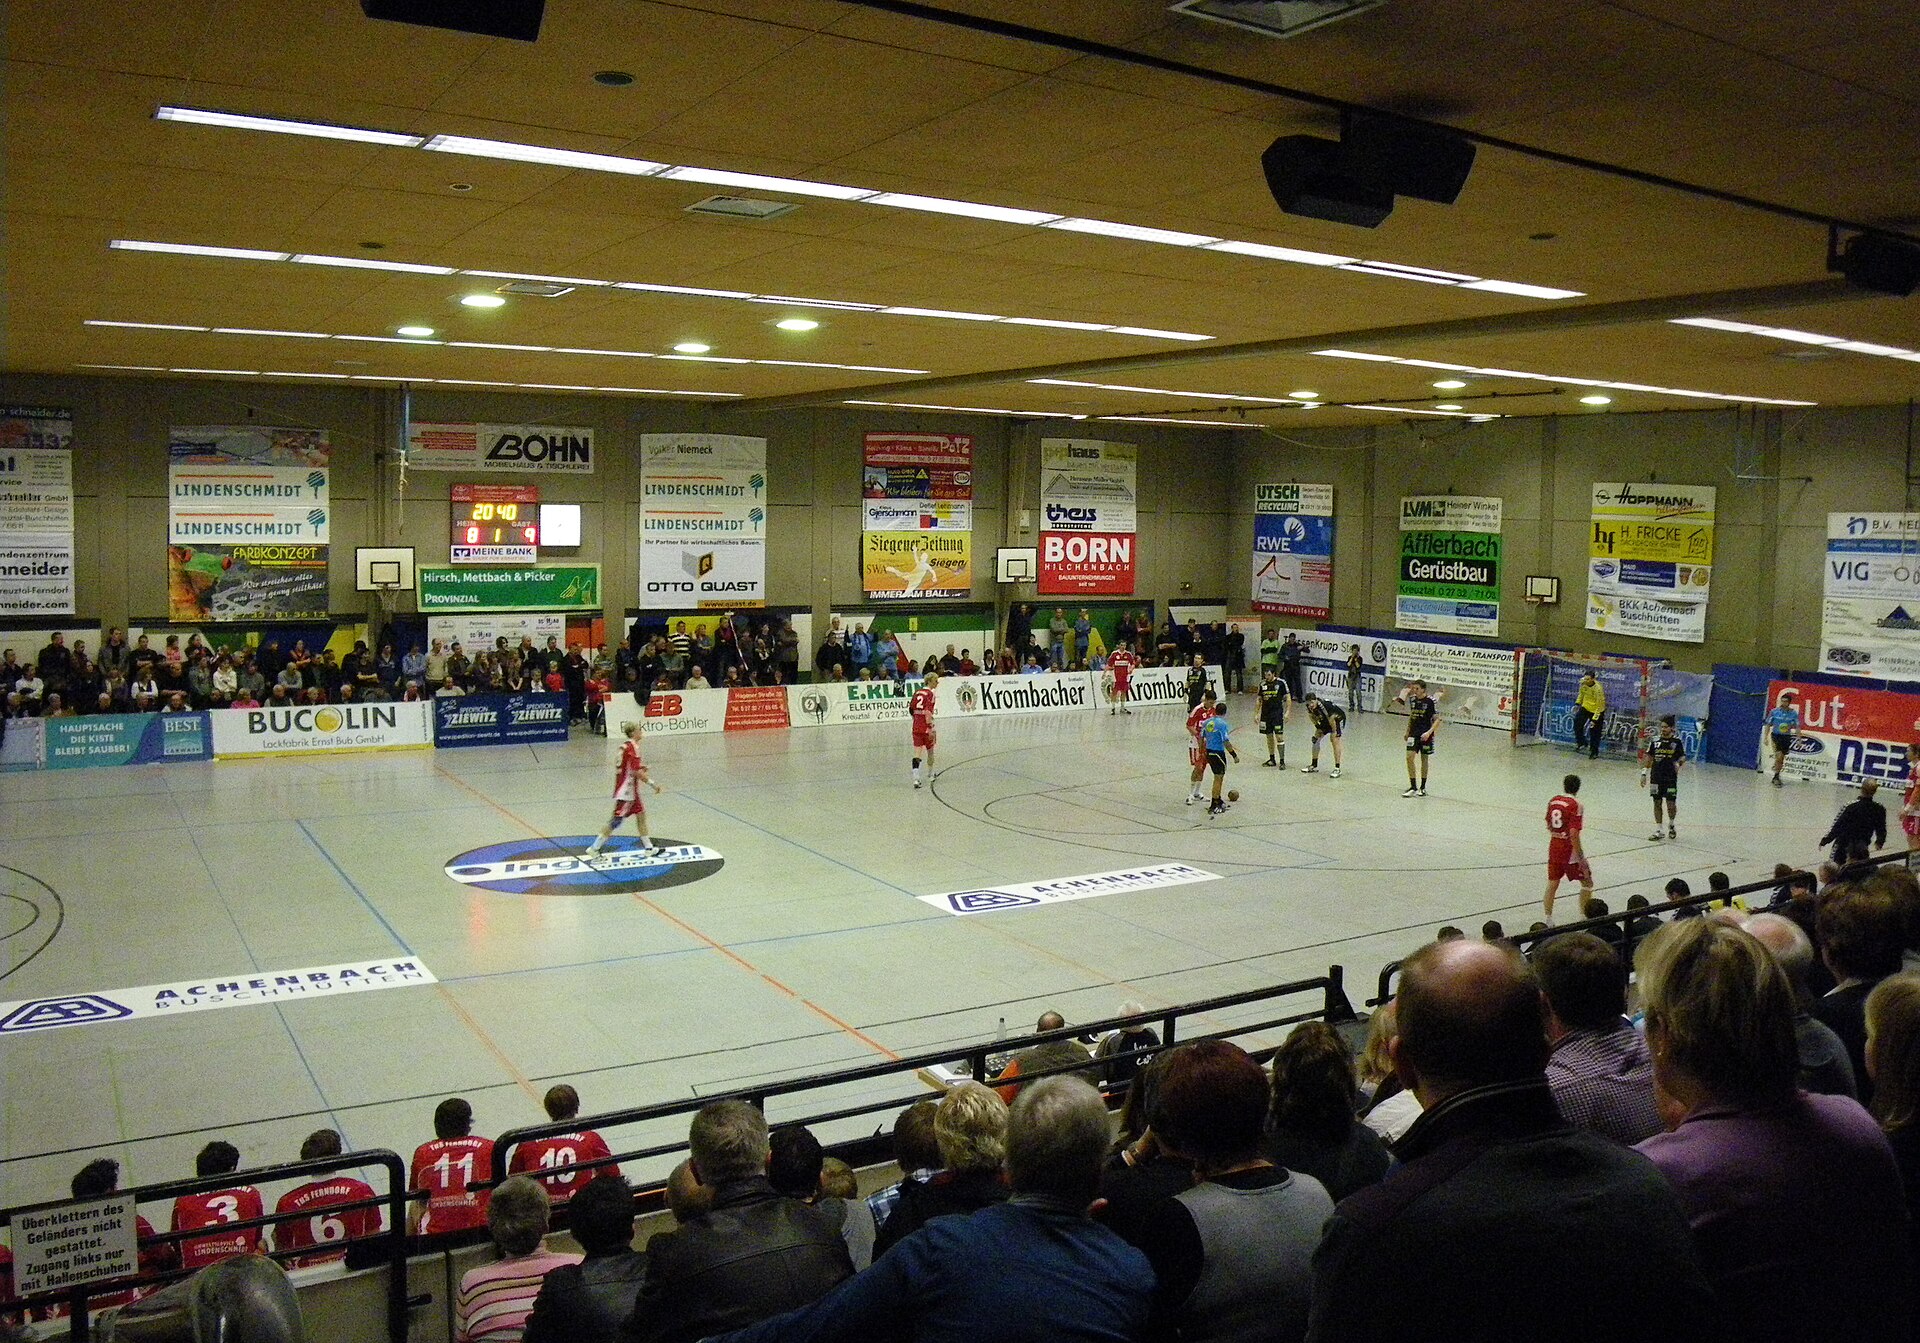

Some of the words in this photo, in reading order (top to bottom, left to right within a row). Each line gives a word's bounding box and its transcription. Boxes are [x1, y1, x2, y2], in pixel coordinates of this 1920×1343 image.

[486, 434, 590, 463] BOHN
[676, 444, 713, 454] Niemeck
[175, 484, 303, 498] LINDENSCHMIDT
[645, 484, 745, 497] LINDENSCHMIDT
[1257, 485, 1300, 500] UTSCH
[1614, 482, 1694, 507] HOPPMANN
[1258, 502, 1298, 512] RECYCLING
[1403, 500, 1432, 517] LVM
[175, 522, 303, 536] LINDENSCHMIDT
[644, 519, 744, 531] LINDENSCHMIDT
[1621, 525, 1632, 539] H.
[1637, 526, 1682, 541] FRICKE
[466, 526, 479, 544] 8
[494, 528, 501, 543] 1
[524, 527, 536, 543] 9
[870, 534, 920, 555] Siegener
[919, 535, 964, 555] Zeitung
[1045, 536, 1131, 564] BORN
[1257, 536, 1291, 551] RWE
[1402, 532, 1499, 558] Afflerbach
[232, 546, 319, 561] FARBKONZEPT
[472, 548, 504, 556] MEINE
[1044, 563, 1131, 571] HILCHENBACH
[1409, 559, 1487, 582] Gerüstbau
[1832, 561, 1869, 581] VIG
[423, 572, 461, 584] Hirsch,
[463, 573, 511, 582] Mettbach
[514, 574, 522, 582] &
[524, 573, 556, 582] Picker
[647, 582, 694, 592] OTTO
[700, 581, 758, 592] QUAST
[869, 590, 903, 599] IMMER
[925, 590, 949, 598] BALL
[1400, 585, 1436, 596] Kreuztal
[1619, 600, 1640, 610] BKK
[1642, 601, 1697, 616] Achenbach
[1620, 610, 1681, 625] Buschhütten
[1447, 649, 1466, 657] TAXI
[916, 696, 923, 708] 2
[980, 678, 1085, 710] Krombacher
[644, 694, 682, 717] EB
[59, 722, 124, 733] HAUPTSACHE
[620, 717, 709, 734] Ektro-Böhler
[70, 735, 87, 744] DIE
[88, 734, 114, 743] KISTE
[262, 738, 310, 749] Lackfabrik
[311, 737, 334, 747] Ernst
[355, 734, 385, 744] GmbH
[1789, 738, 1815, 752] Ford
[55, 746, 86, 756] BLEIBT
[88, 744, 130, 754] SAUBER!
[1551, 809, 1562, 829] 8
[1032, 865, 1193, 893] ACHENBACH
[154, 962, 418, 1001] ACHENBACH
[155, 972, 423, 1009] BUSCHHÜTTEN
[433, 1152, 474, 1188] 11
[540, 1147, 577, 1184] 10
[310, 1186, 351, 1200] FERNDORF
[22, 1208, 100, 1231] Überklettern
[103, 1204, 125, 1217] des
[27, 1227, 89, 1245] Geländers
[92, 1219, 122, 1234] nicht
[45, 1237, 107, 1258] gestattet.
[26, 1260, 71, 1276] Zugang
[73, 1253, 102, 1267] links
[105, 1248, 125, 1260] nur
[21, 1279, 42, 1292] mit
[46, 1262, 131, 1287] Hallenschuhen
